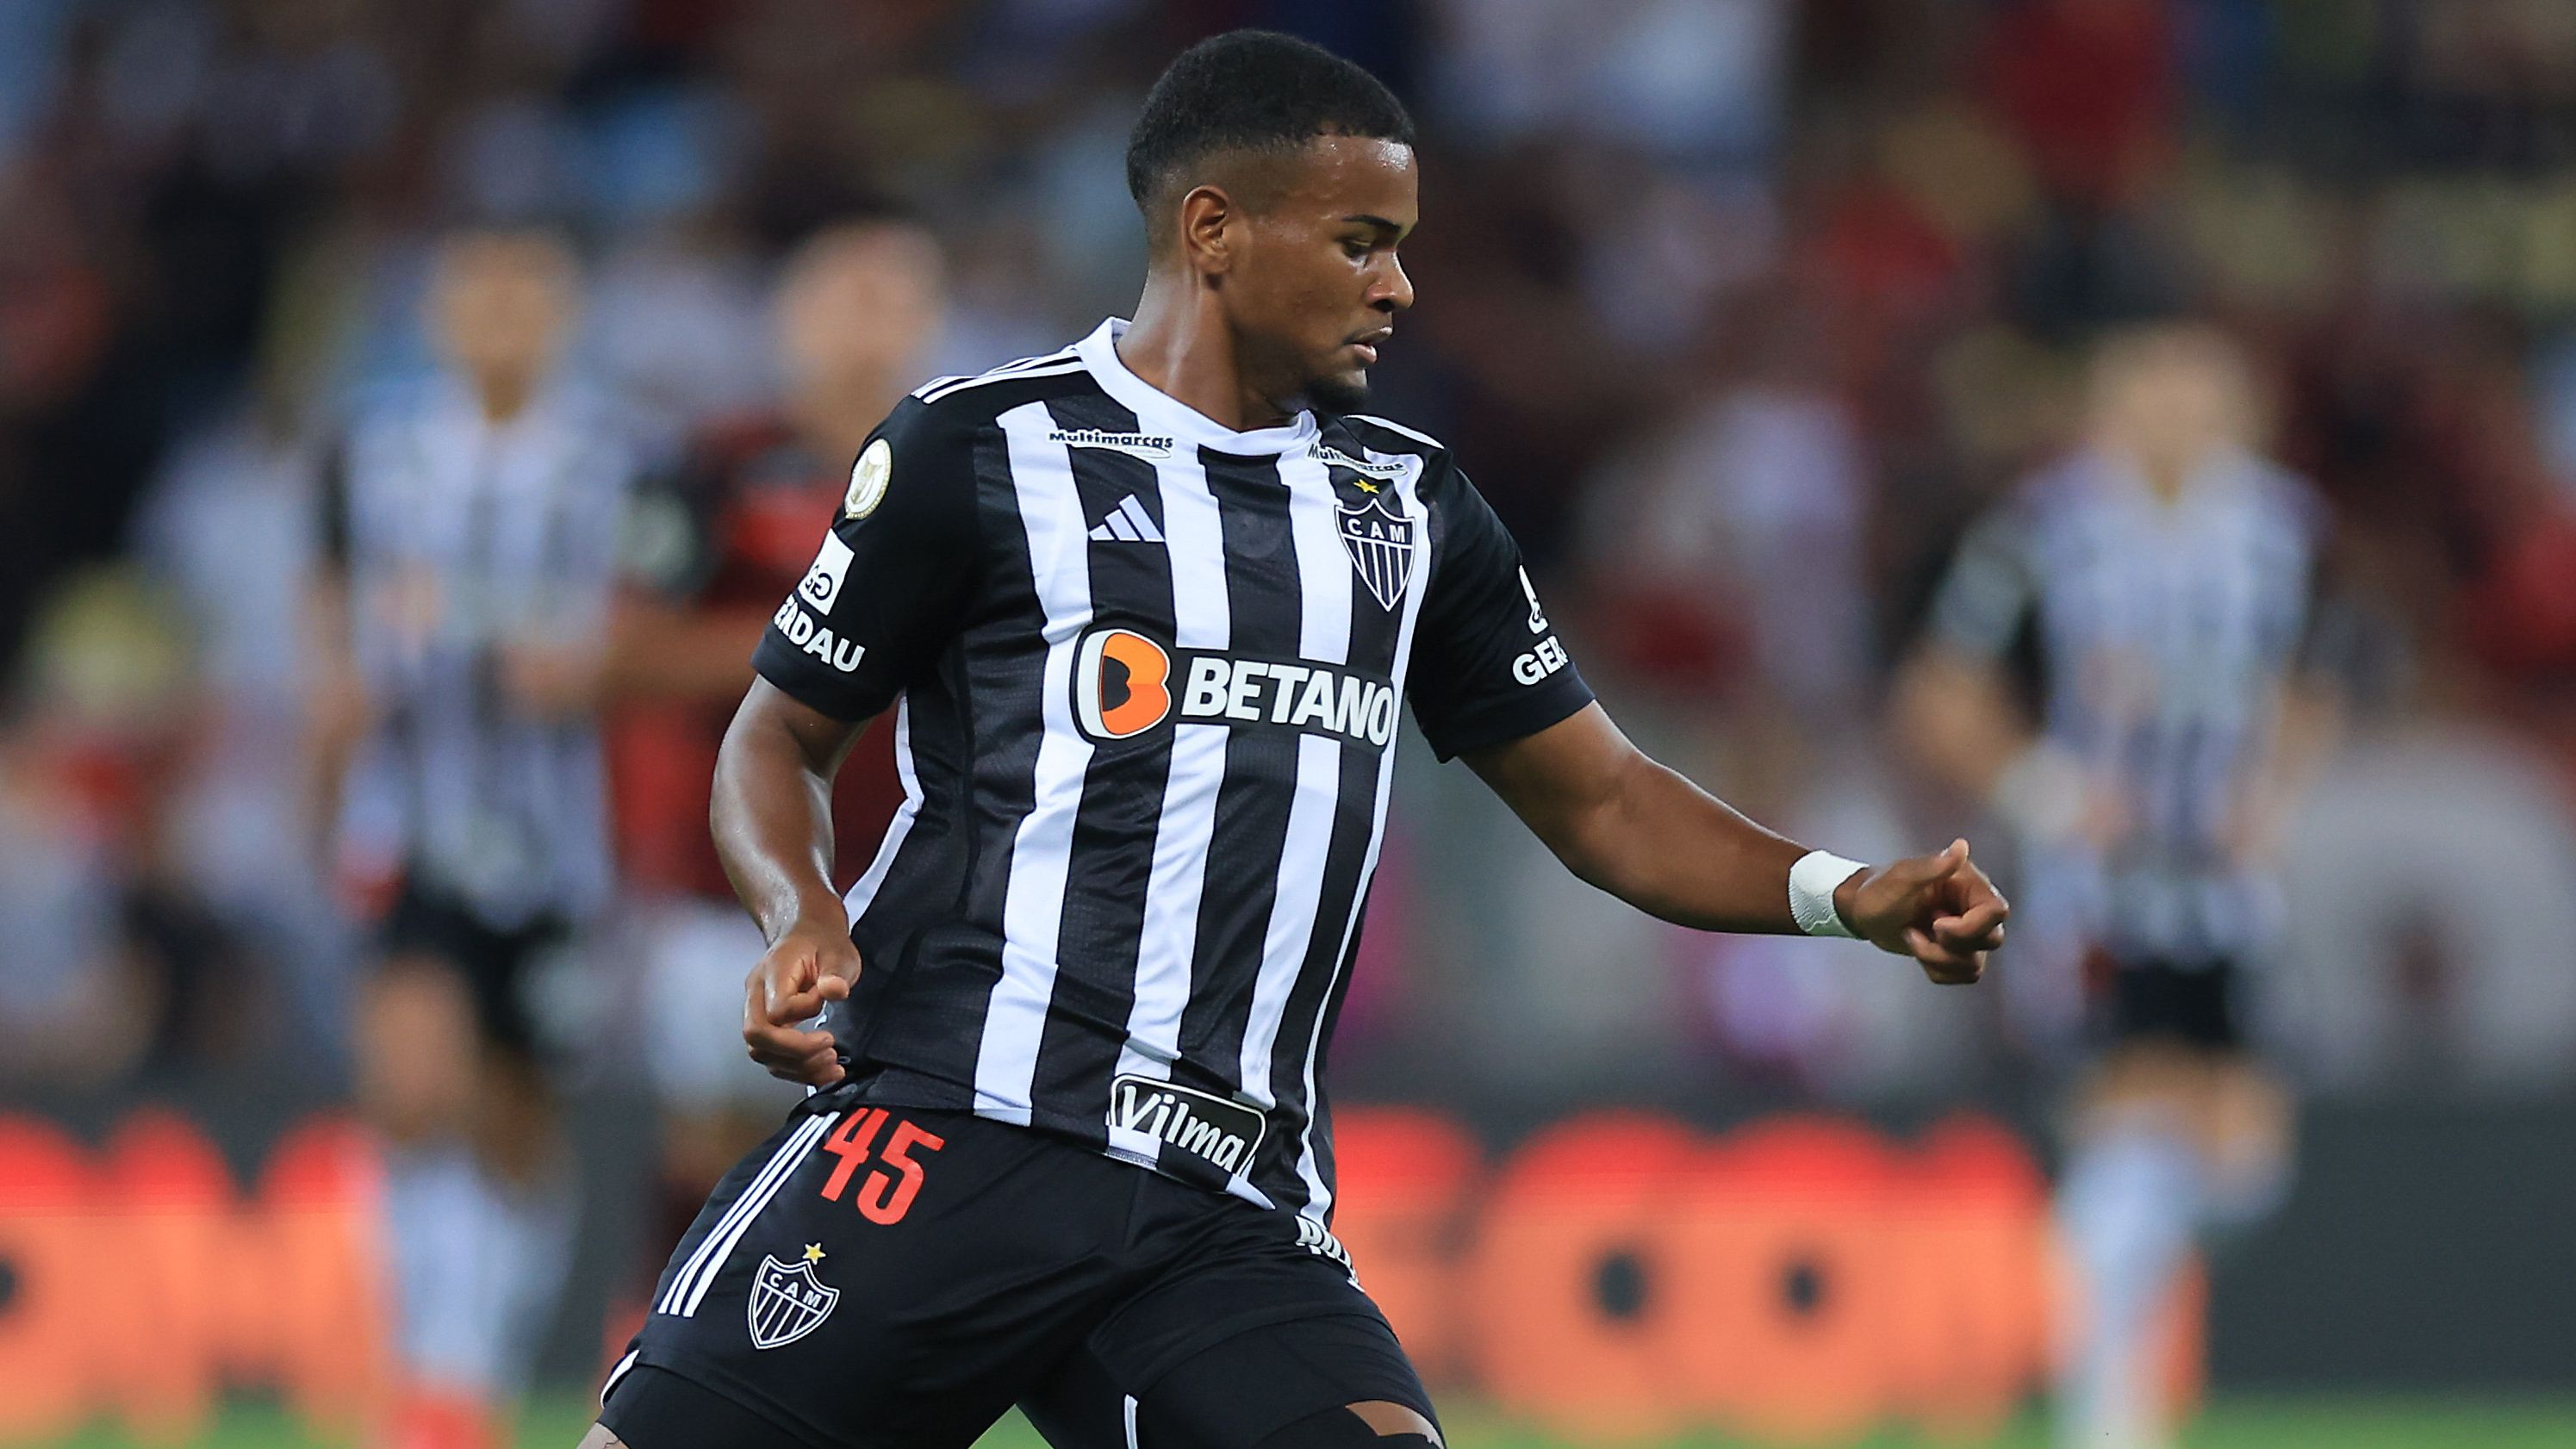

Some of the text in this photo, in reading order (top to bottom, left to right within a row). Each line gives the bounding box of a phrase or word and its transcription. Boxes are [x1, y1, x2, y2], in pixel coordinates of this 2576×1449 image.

[1048, 432, 1173, 449] Multimarcas
[1347, 518, 1406, 544] CAM
[1181, 656, 1394, 746] BETANO
[1122, 1085, 1246, 1173] Vilma
[820, 1107, 945, 1226] 45
[769, 1273, 823, 1309] CAM
